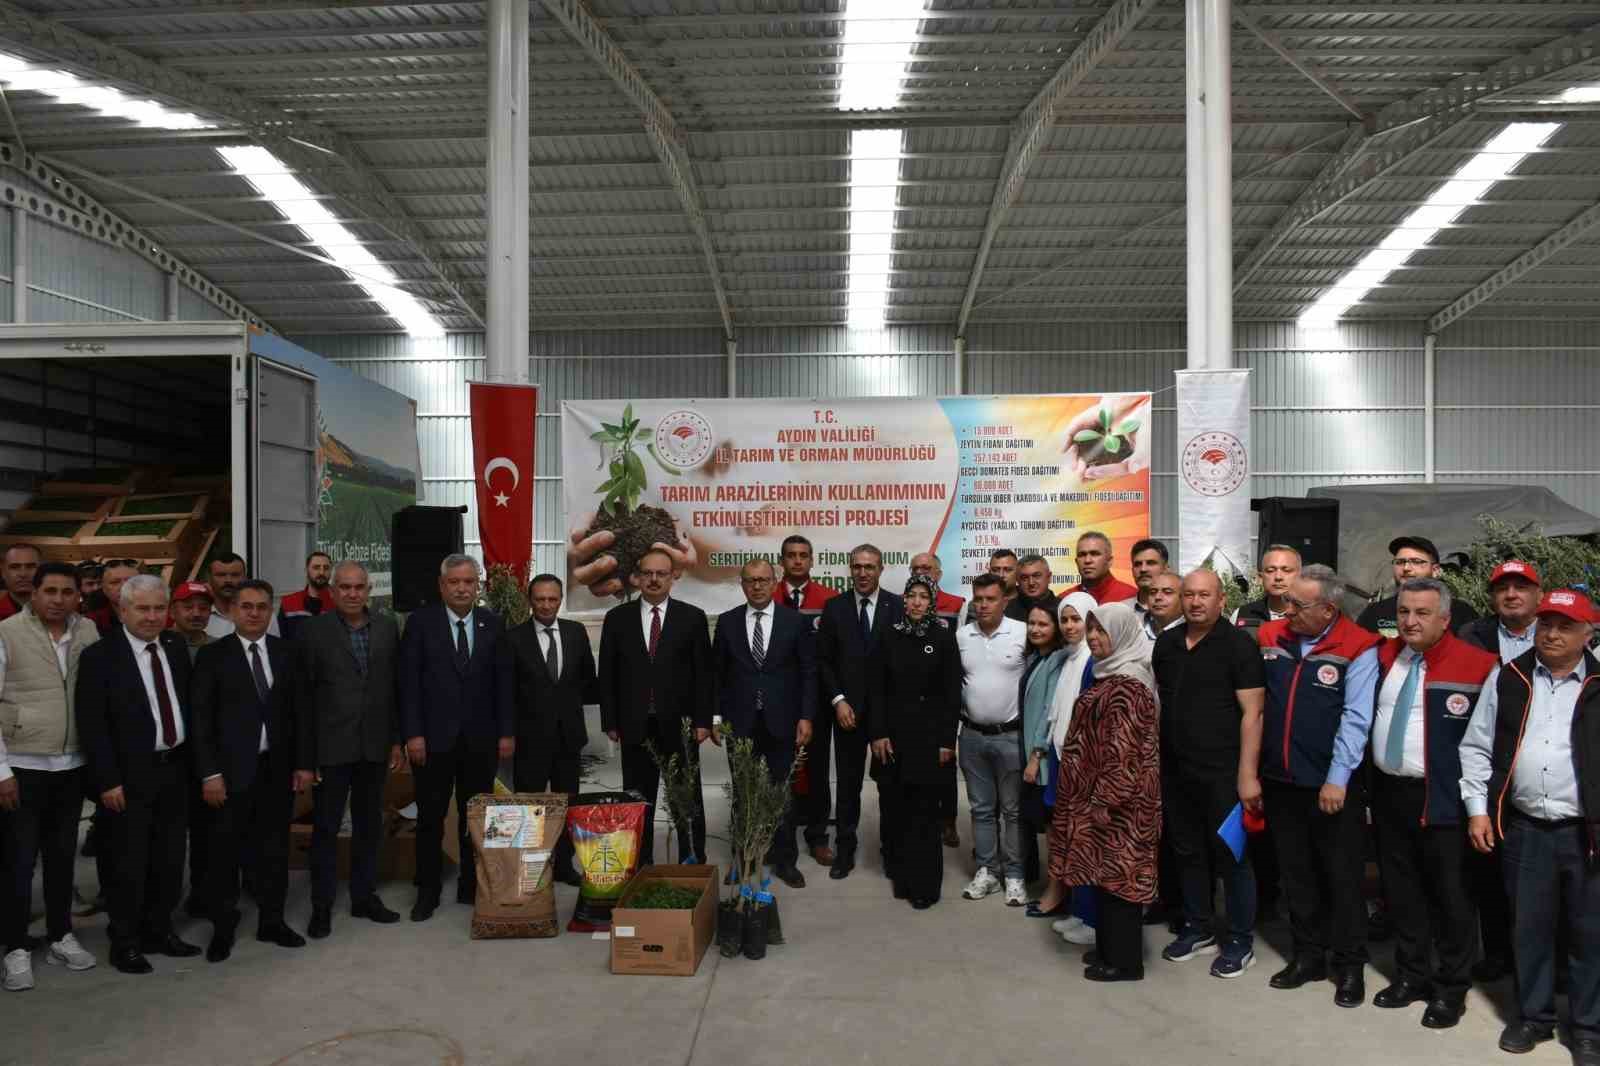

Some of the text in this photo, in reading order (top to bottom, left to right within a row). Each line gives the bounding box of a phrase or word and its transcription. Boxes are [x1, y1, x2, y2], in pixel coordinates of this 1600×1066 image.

[814, 410, 837, 424] T.C.
[777, 426, 875, 443] AYDIN VALİLİĞİ
[732, 447, 774, 463] TARIM
[779, 447, 795, 462] VE
[799, 446, 848, 462] ORMAN
[853, 442, 936, 461] MÜDÜRLÜĞÜ
[660, 480, 946, 503] TARIM ARAZİLERİNİN KULLANIMININ
[693, 505, 908, 529] ETKİNLEŞTİRİLMESİ PROJESİ
[345, 542, 369, 561] Sebze
